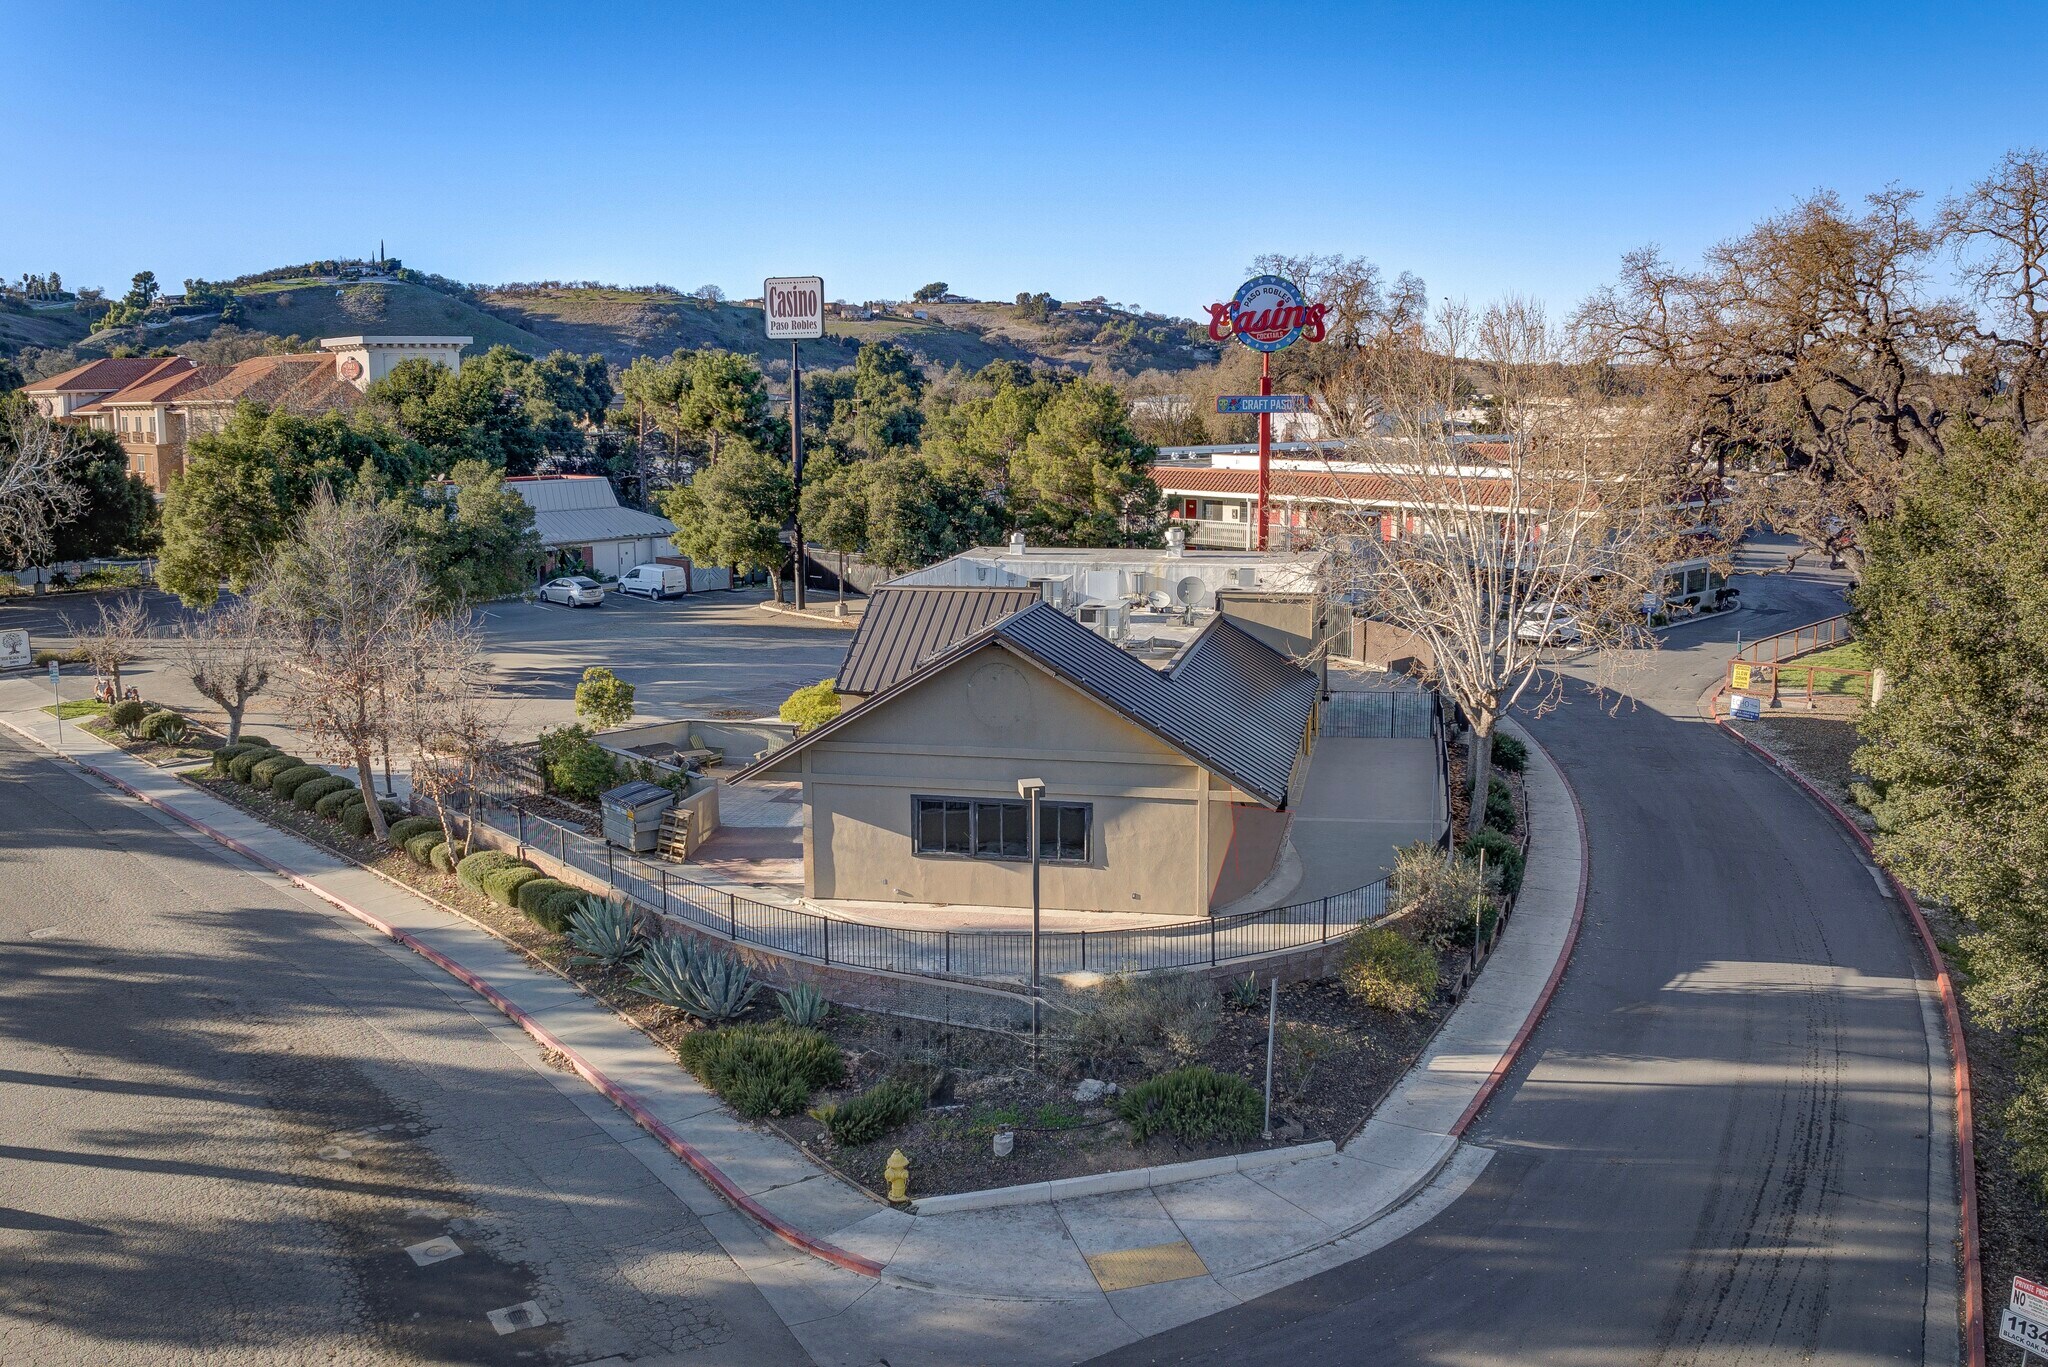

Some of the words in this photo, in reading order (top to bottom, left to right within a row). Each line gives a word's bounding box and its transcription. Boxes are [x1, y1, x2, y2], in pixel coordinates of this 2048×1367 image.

[769, 286, 818, 318] Casino
[1243, 289, 1261, 308] PASO
[1263, 287, 1291, 304] ROBLES
[770, 321, 789, 331] Paso
[791, 320, 818, 330] Robles
[1256, 331, 1284, 340] COCKTAILS
[1242, 399, 1269, 410] CRAFT
[2015, 1279, 2035, 1292] PRIVATE
[2013, 1290, 2026, 1306] NO
[2008, 1316, 2048, 1346] 1134
[2003, 1330, 2025, 1345] BLACK
[2026, 1340, 2040, 1351] OAK
